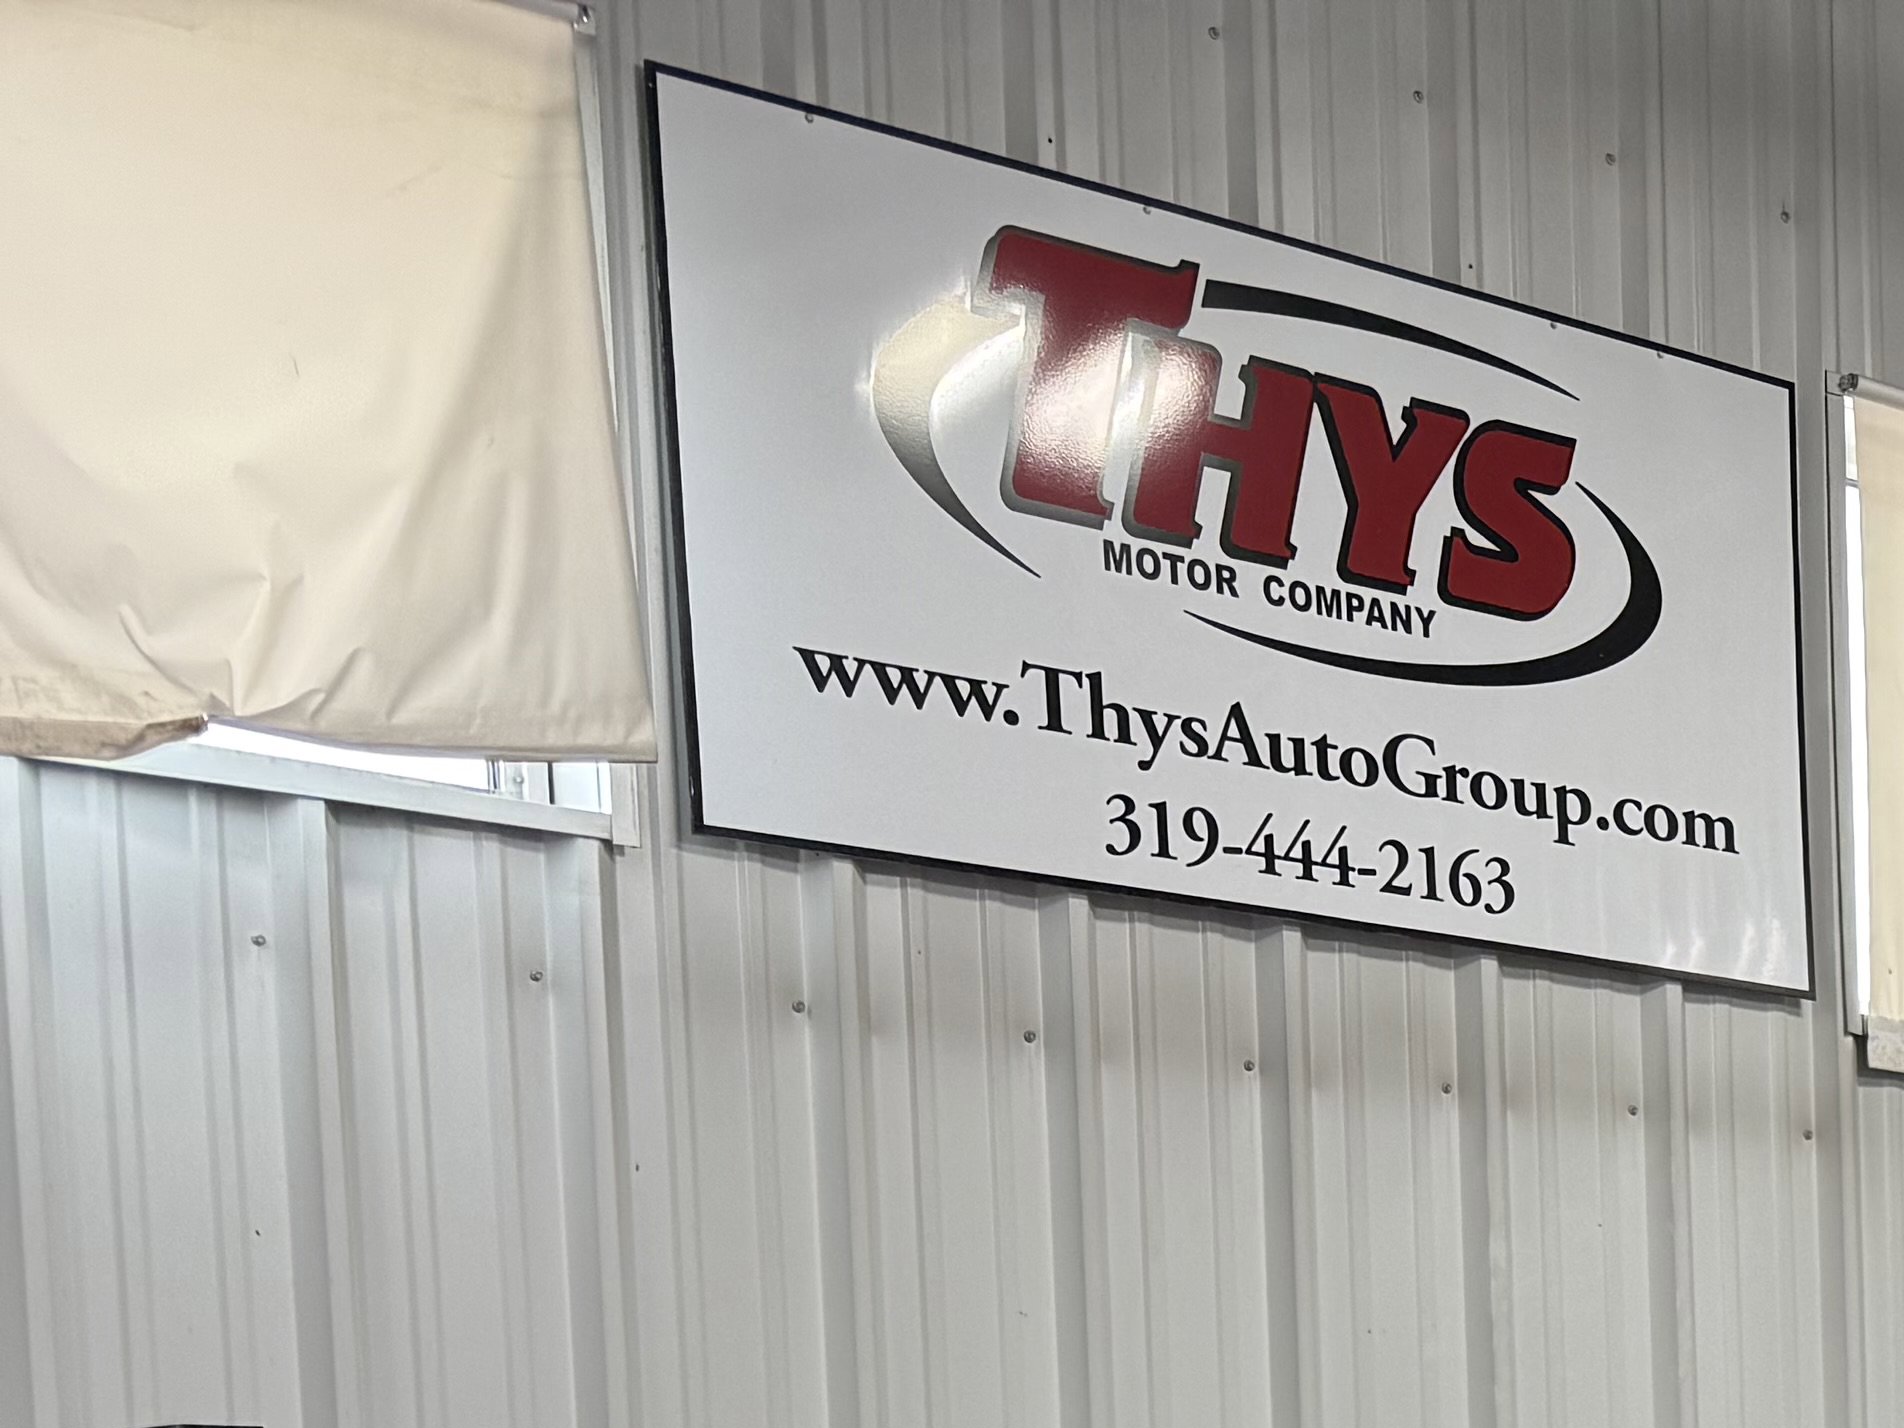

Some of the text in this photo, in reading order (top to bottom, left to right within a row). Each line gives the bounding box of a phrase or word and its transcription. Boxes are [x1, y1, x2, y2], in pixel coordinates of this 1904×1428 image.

[970, 225, 1578, 622] THYS
[1103, 537, 1438, 640] MOTOR COMPANY
[792, 646, 1741, 856] www.ThysAutoGroup.com
[1104, 792, 1517, 916] 319-444-2163
